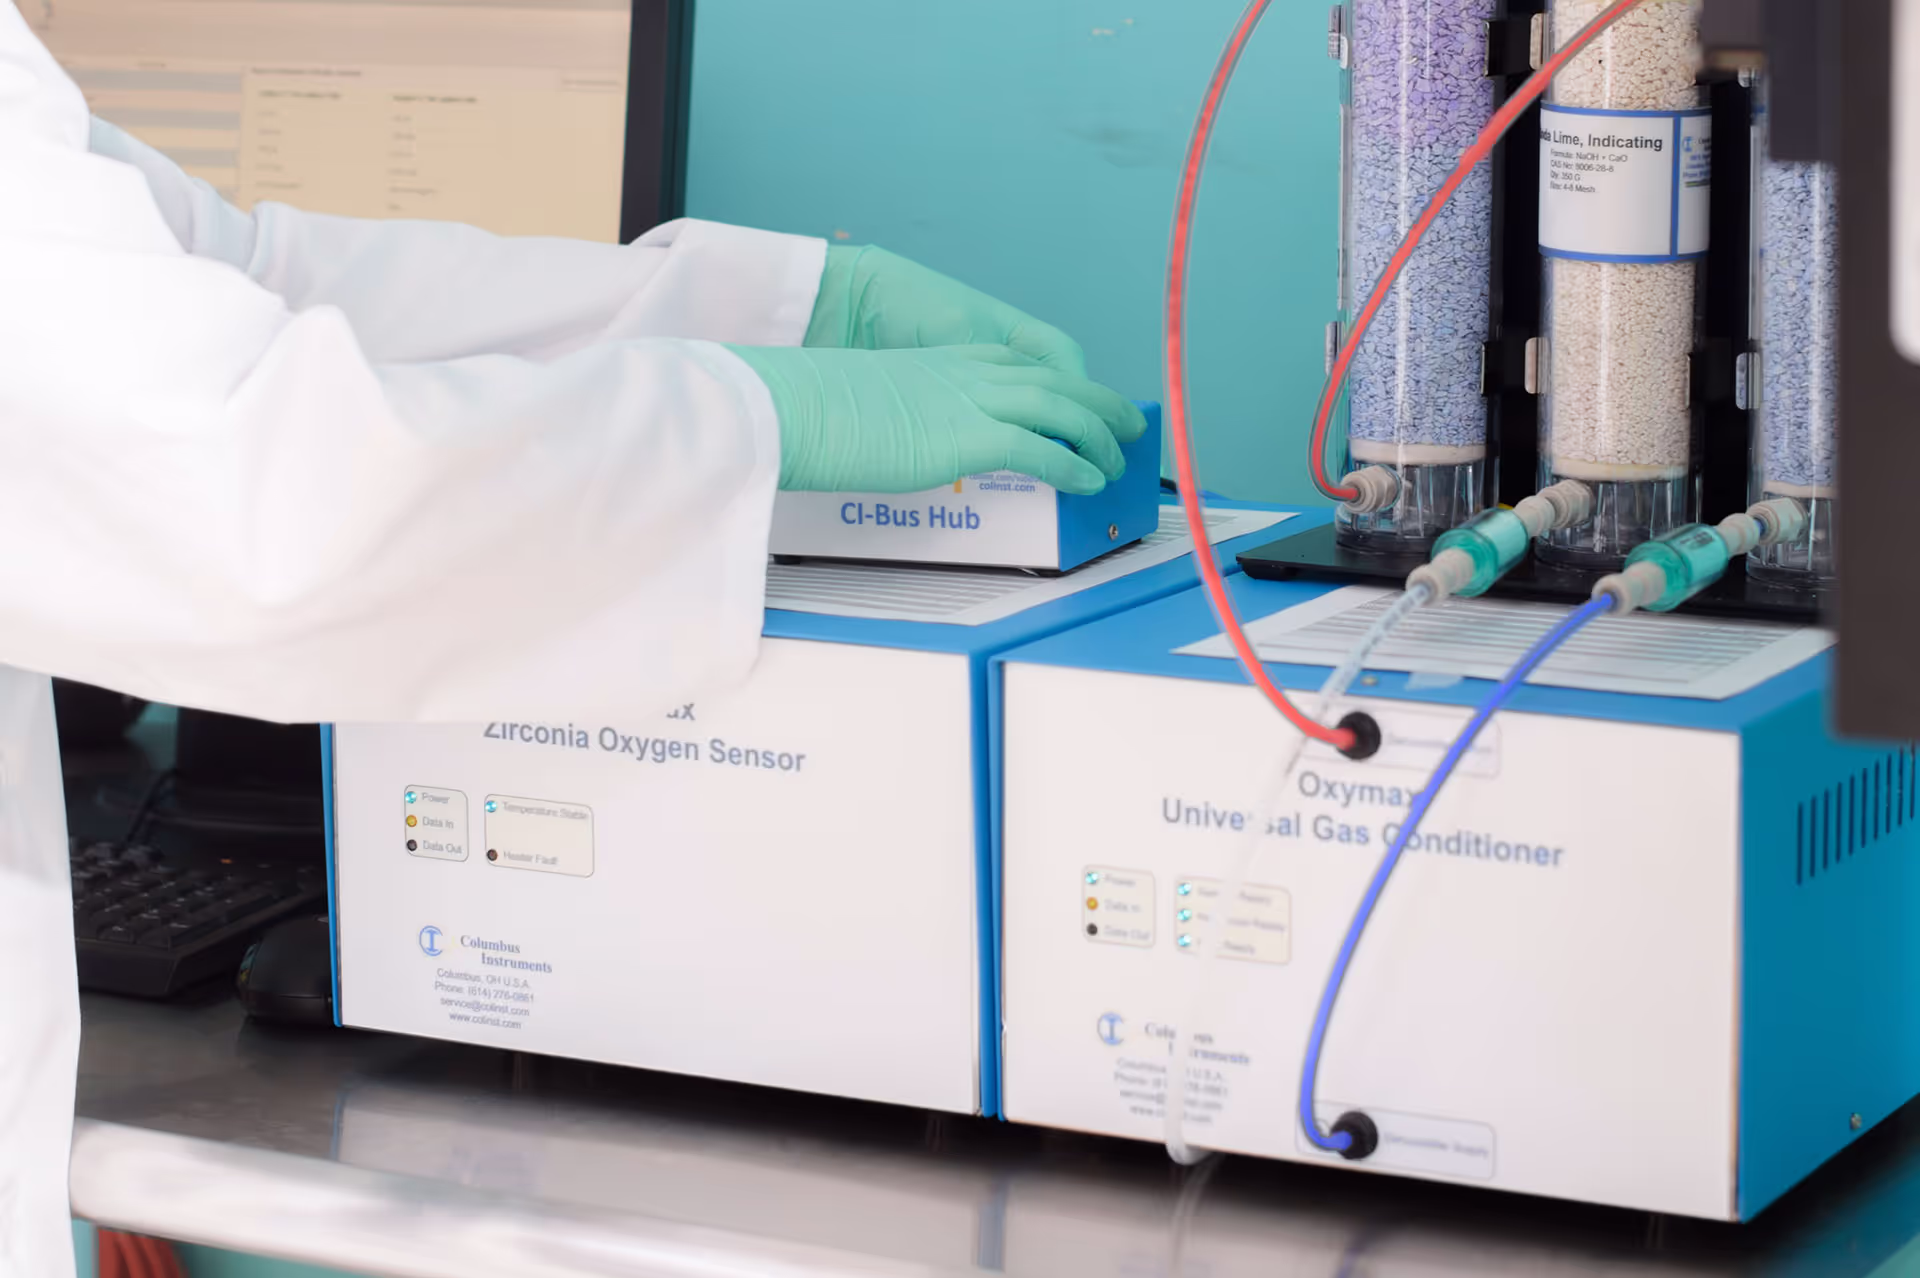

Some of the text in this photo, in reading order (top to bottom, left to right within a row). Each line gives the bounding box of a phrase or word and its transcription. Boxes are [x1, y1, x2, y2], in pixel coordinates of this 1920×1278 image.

[1553, 130, 1583, 148] Lime,
[1588, 133, 1663, 151] Indicating
[1576, 152, 1599, 161] NaOH
[1608, 154, 1628, 162] CaO
[979, 481, 1036, 493] colinst.com
[840, 502, 981, 530] CI-Bus Hub
[483, 722, 806, 772] Zirconia Oxygen Sensor
[422, 792, 451, 804] Power
[503, 802, 559, 818] Temperature
[422, 816, 454, 829] Data In
[1162, 797, 1564, 867] Univeal Gas Conditioner
[423, 840, 463, 855] Data Out
[460, 934, 521, 954] Columbus
[481, 952, 553, 973] Instruments
[449, 1011, 522, 1030] www.colinst.com
